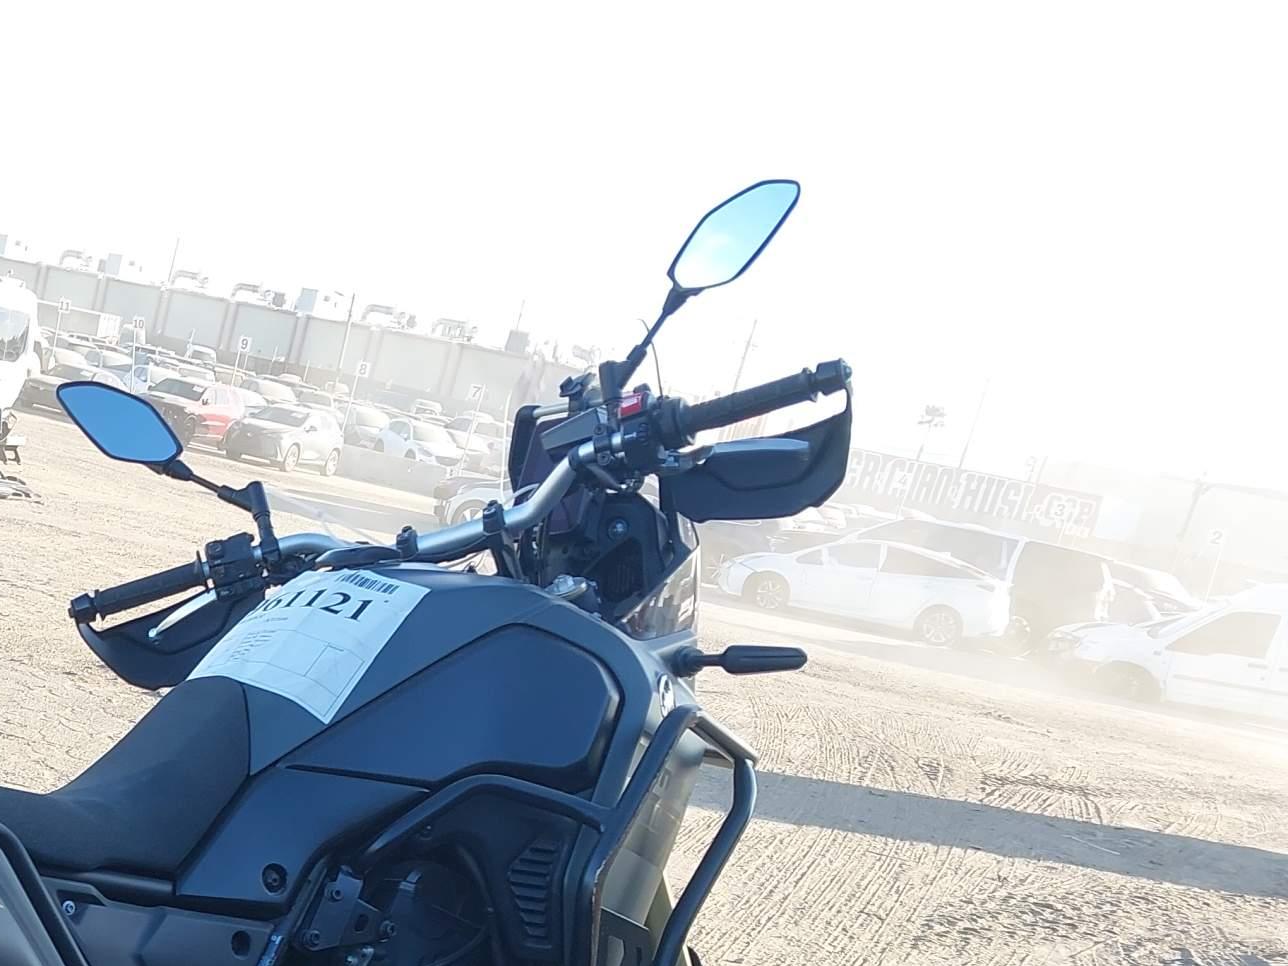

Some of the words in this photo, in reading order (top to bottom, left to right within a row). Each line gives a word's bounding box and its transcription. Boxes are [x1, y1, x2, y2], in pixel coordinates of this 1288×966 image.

[59, 300, 70, 311] 11
[134, 319, 144, 329] 10
[240, 338, 249, 350] 9
[359, 363, 368, 375] 8
[471, 385, 481, 398] 7
[1053, 503, 1065, 517] 3
[1209, 530, 1223, 545] 2
